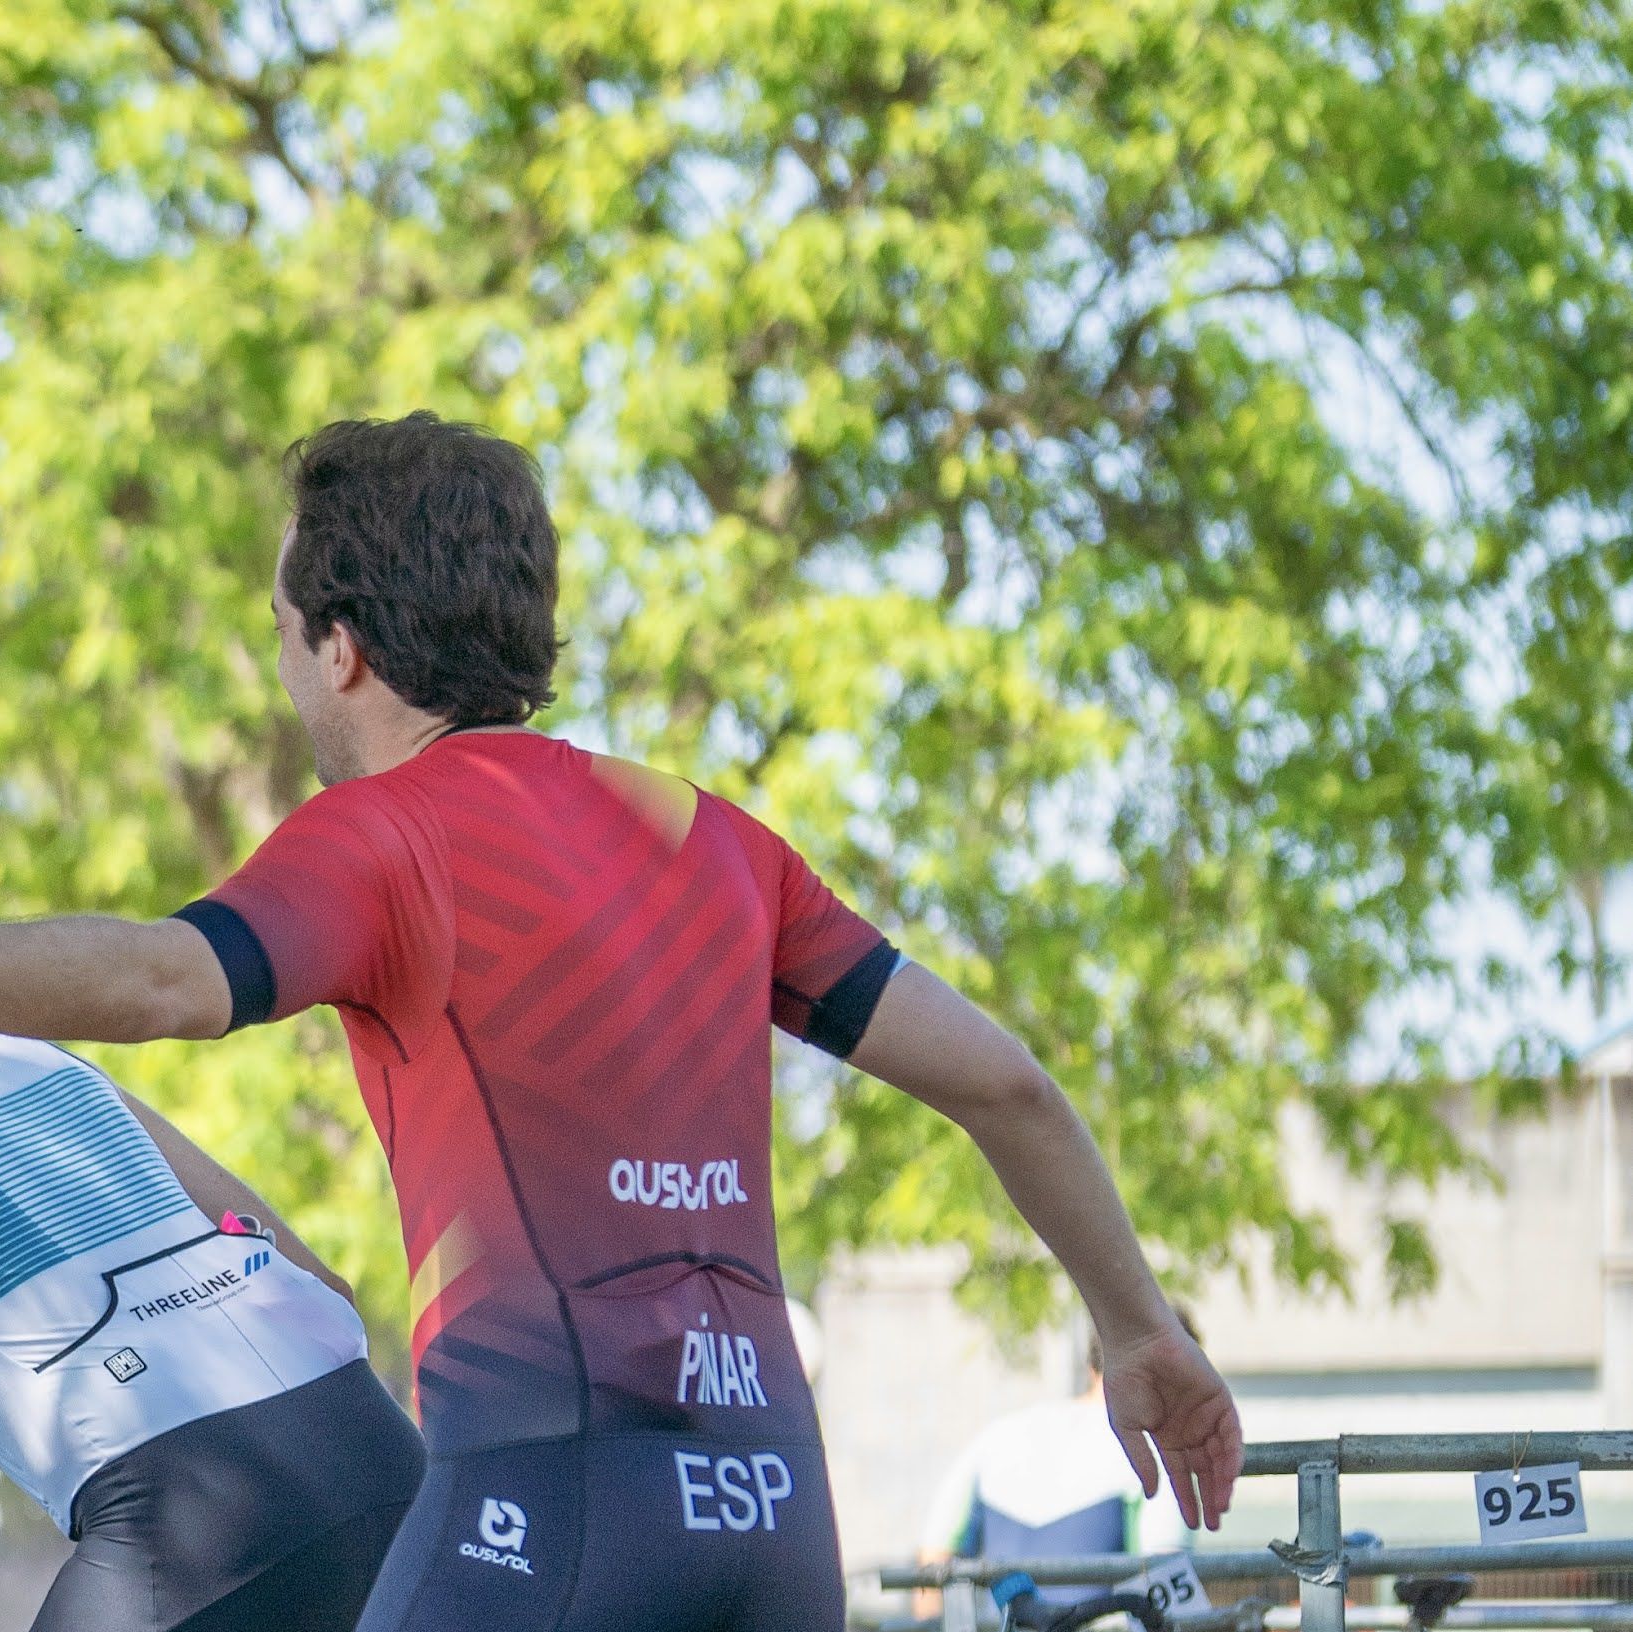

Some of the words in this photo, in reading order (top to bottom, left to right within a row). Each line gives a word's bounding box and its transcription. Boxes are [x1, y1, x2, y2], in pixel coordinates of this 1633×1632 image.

[609, 1158, 749, 1211] austral
[128, 1269, 241, 1322] THREELINE
[674, 1451, 794, 1532] ESP
[1483, 1477, 1577, 1527] 925
[458, 1542, 535, 1575] austral
